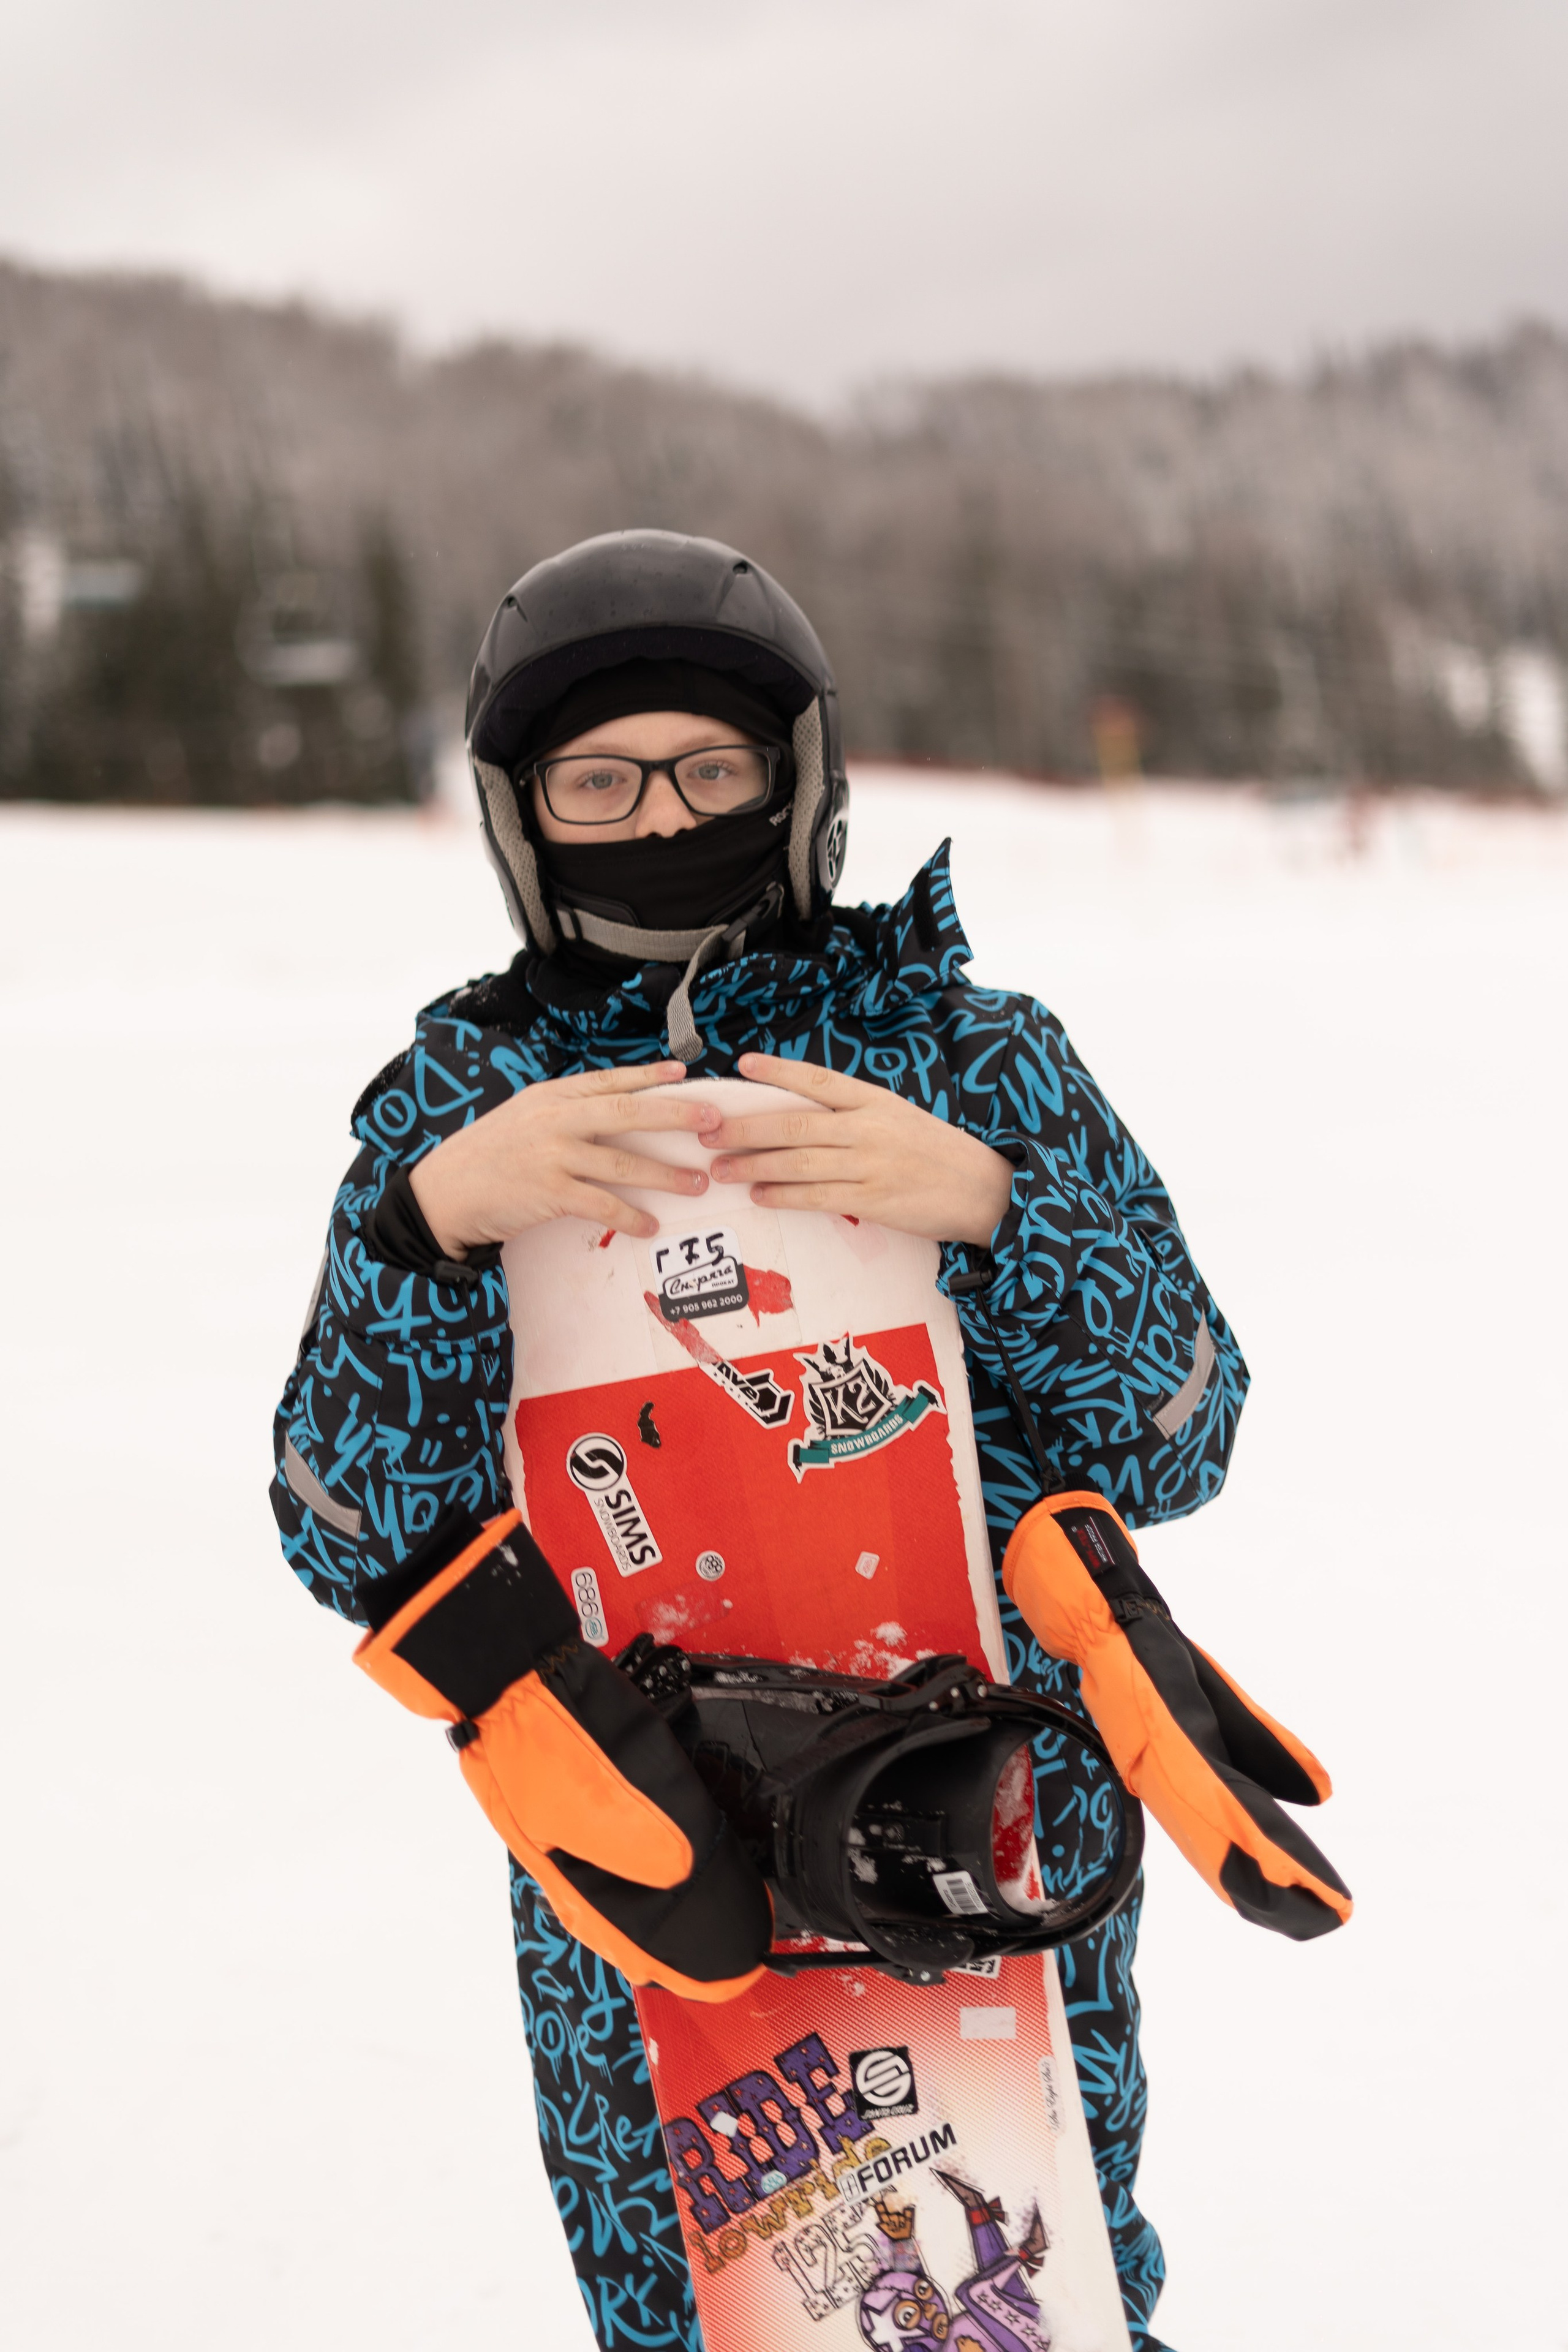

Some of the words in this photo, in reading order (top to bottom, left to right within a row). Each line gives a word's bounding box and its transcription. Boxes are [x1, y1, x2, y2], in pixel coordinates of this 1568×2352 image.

[670, 1305, 681, 1316] +7
[719, 1294, 743, 1307] 2000
[827, 1379, 878, 1425] K2
[830, 1413, 905, 1456] SNOWBOARDS
[594, 1498, 631, 1572] SNOWBOARDS
[605, 1489, 656, 1566] SIMS
[575, 1572, 599, 1618] 686
[662, 2032, 875, 2235] RIDE
[856, 2123, 957, 2193] FORUM
